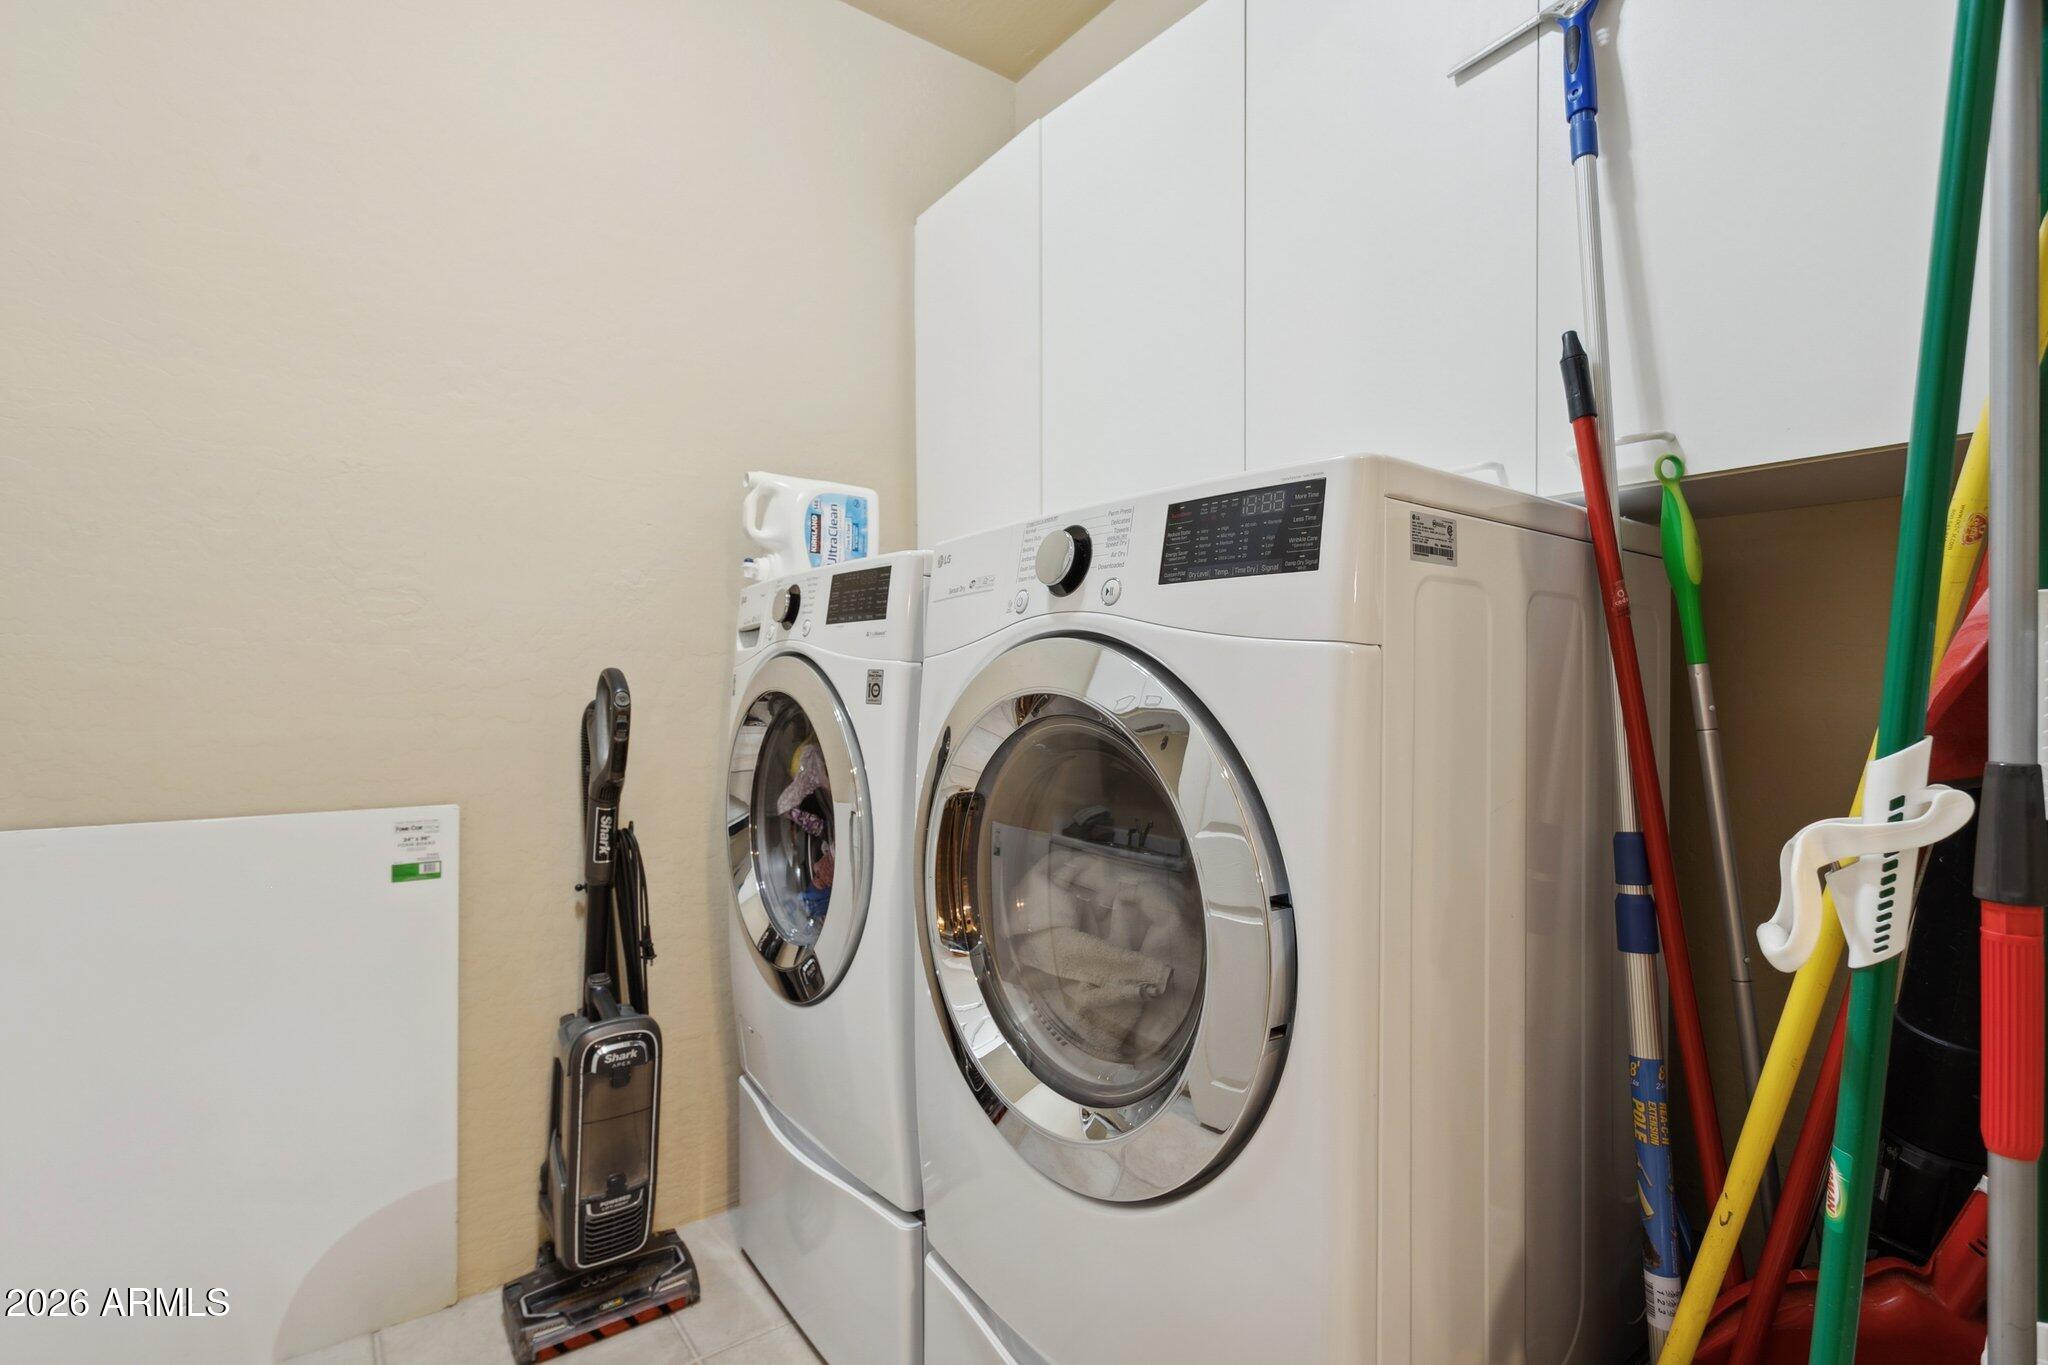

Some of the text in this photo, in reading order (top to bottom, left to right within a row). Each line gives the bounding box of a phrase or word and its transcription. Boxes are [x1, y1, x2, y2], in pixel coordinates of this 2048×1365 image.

[810, 514, 818, 552] KIRKLAND
[1097, 561, 1125, 570] Downloaded
[1214, 568, 1230, 577] Temp.
[1235, 565, 1256, 574] Time Dry
[1261, 564, 1279, 573] Signal
[1188, 572, 1197, 580] Dry
[868, 683, 881, 698] 10
[599, 815, 612, 855] Shark
[604, 1049, 638, 1064] Shark
[1632, 1097, 1648, 1144] POLE
[1648, 1100, 1660, 1146] EXTENSION
